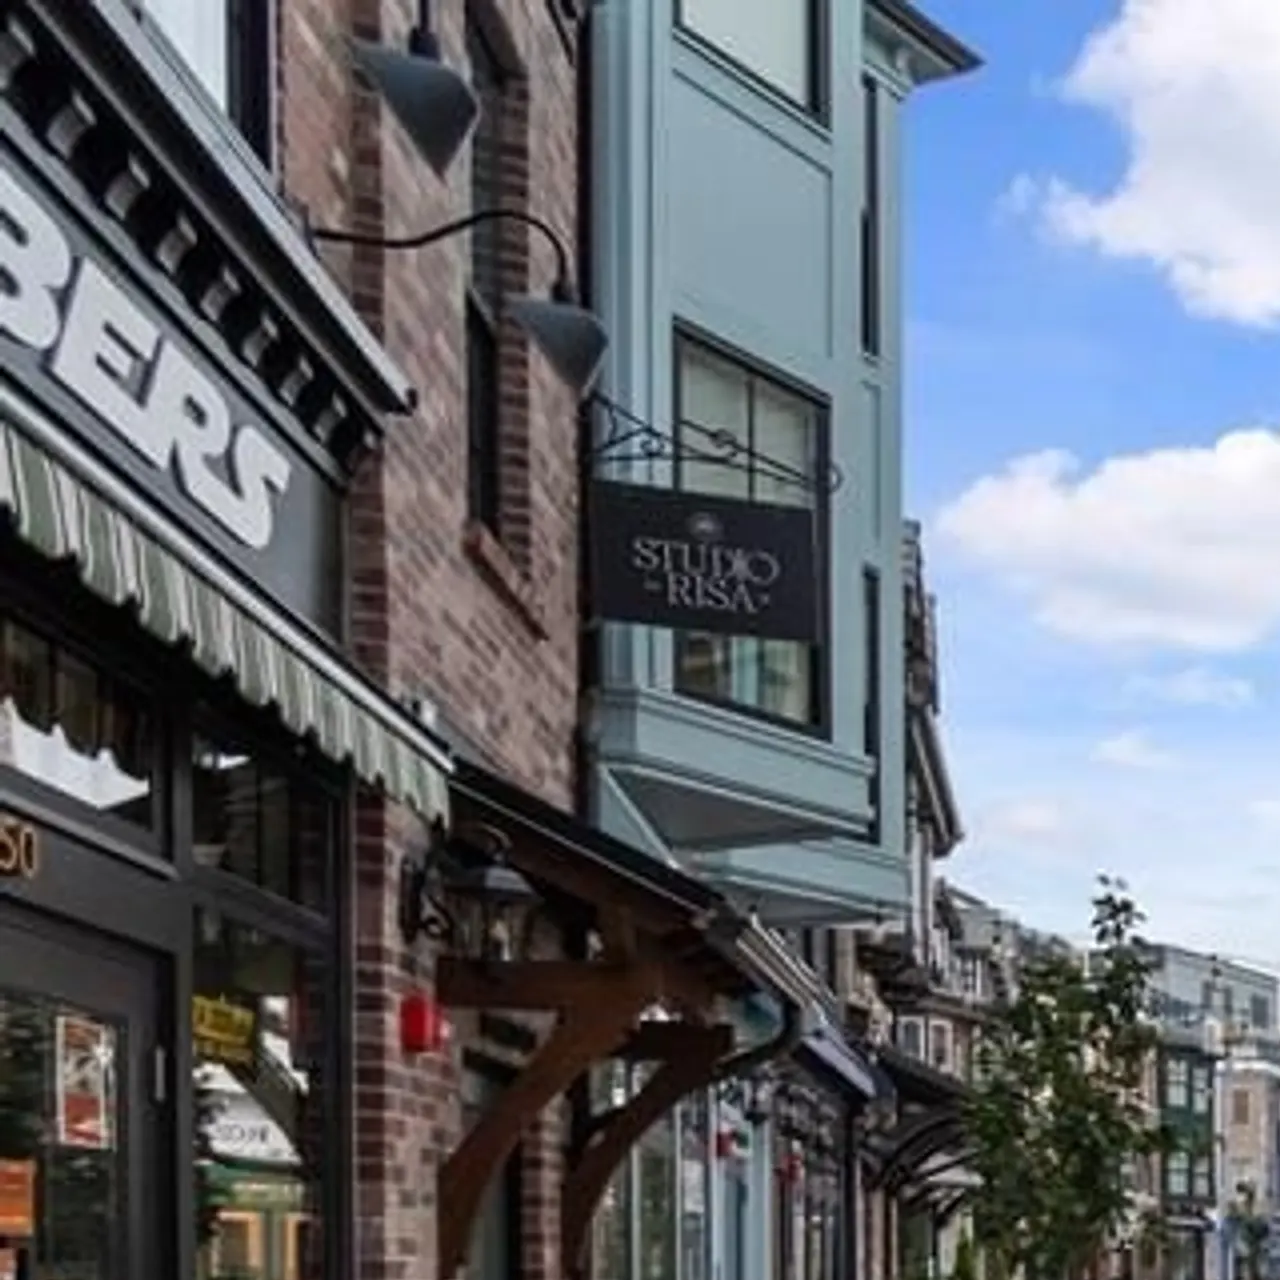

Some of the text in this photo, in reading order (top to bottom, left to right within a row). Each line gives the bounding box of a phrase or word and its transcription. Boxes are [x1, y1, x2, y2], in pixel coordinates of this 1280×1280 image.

[0, 166, 291, 550] BERS
[632, 536, 781, 585] STUDIO
[668, 570, 758, 614] RISA
